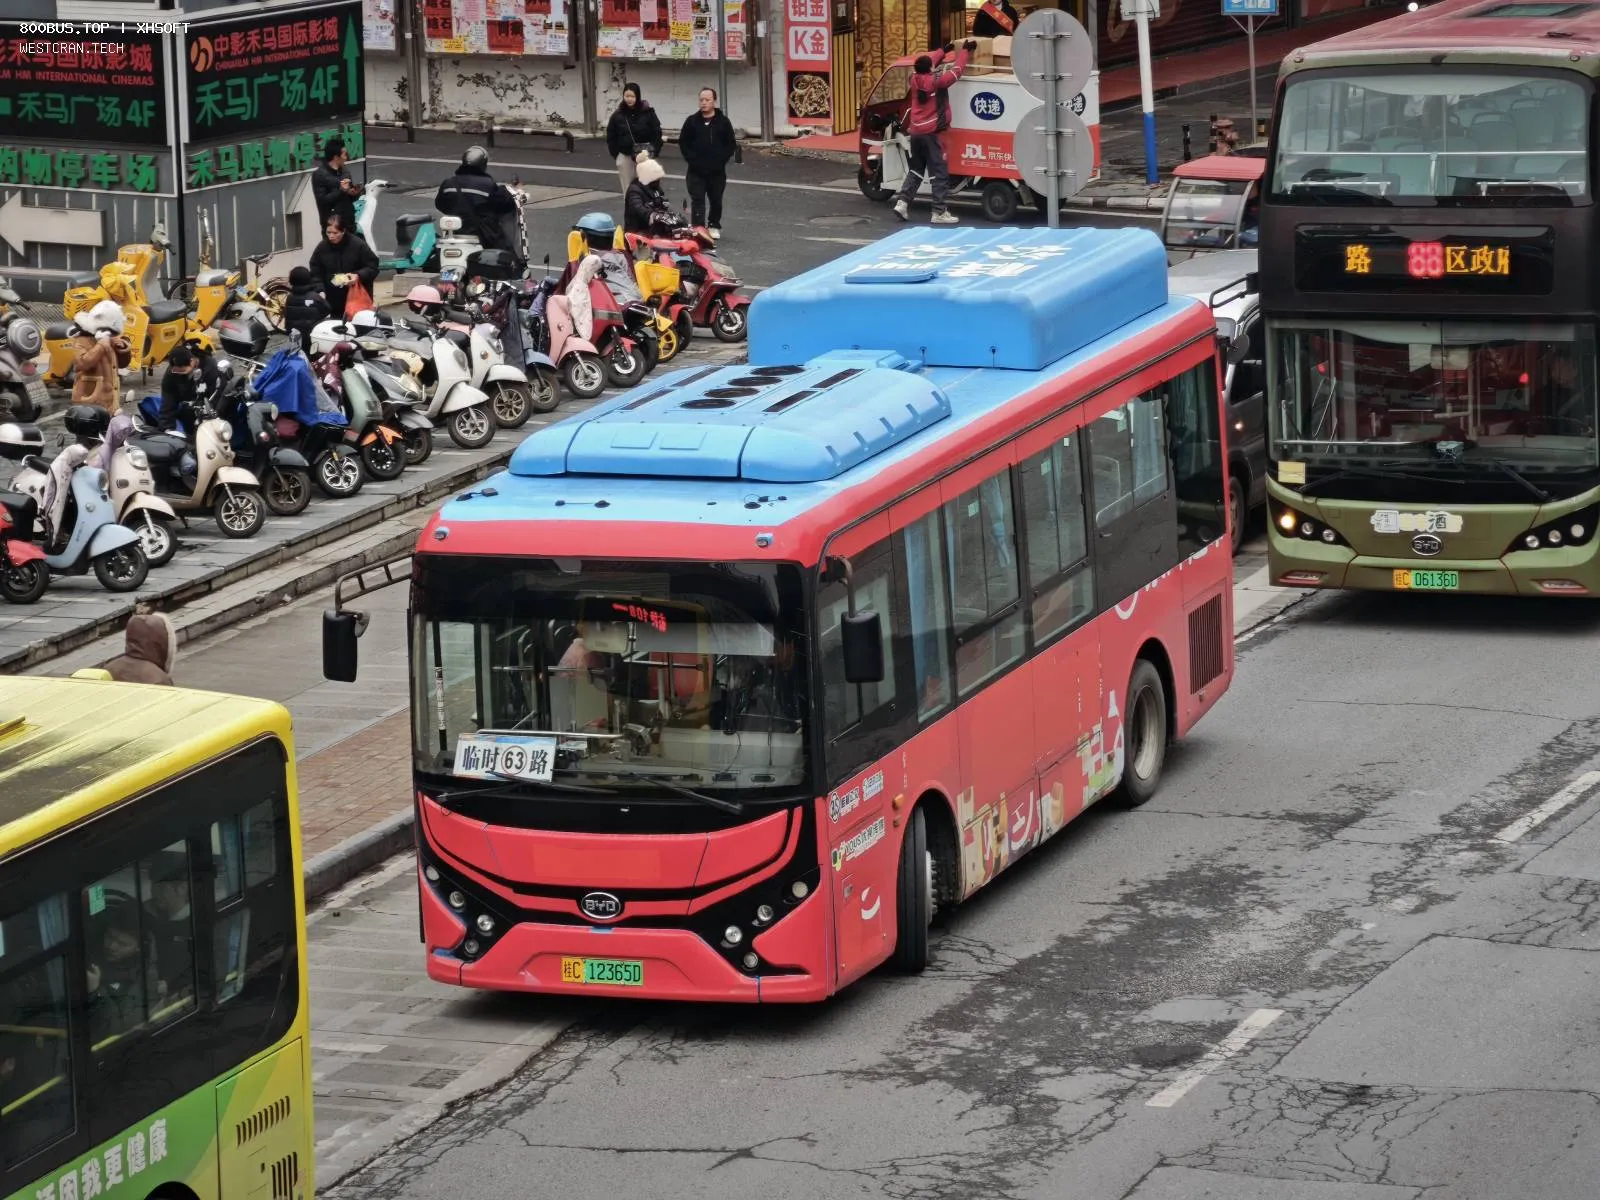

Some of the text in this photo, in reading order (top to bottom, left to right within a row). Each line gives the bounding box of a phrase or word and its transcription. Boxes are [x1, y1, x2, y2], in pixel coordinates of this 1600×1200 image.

[214, 17, 339, 57] 中影禾马国际影城
[794, 29, 825, 55] K金
[36, 71, 107, 85] INTERNATIONAL
[112, 75, 154, 86] CINEMAS
[195, 65, 340, 128] 禾马广场4F
[18, 92, 156, 128] 禾马广场4F
[974, 98, 1000, 115] 快递
[962, 144, 986, 159] JDL
[988, 152, 1017, 161] 京东快
[1345, 245, 1371, 273] 路
[1408, 242, 1443, 276] 88
[1415, 572, 1457, 587] 06136D
[585, 899, 616, 912] BYD
[589, 962, 641, 983] 12365D
